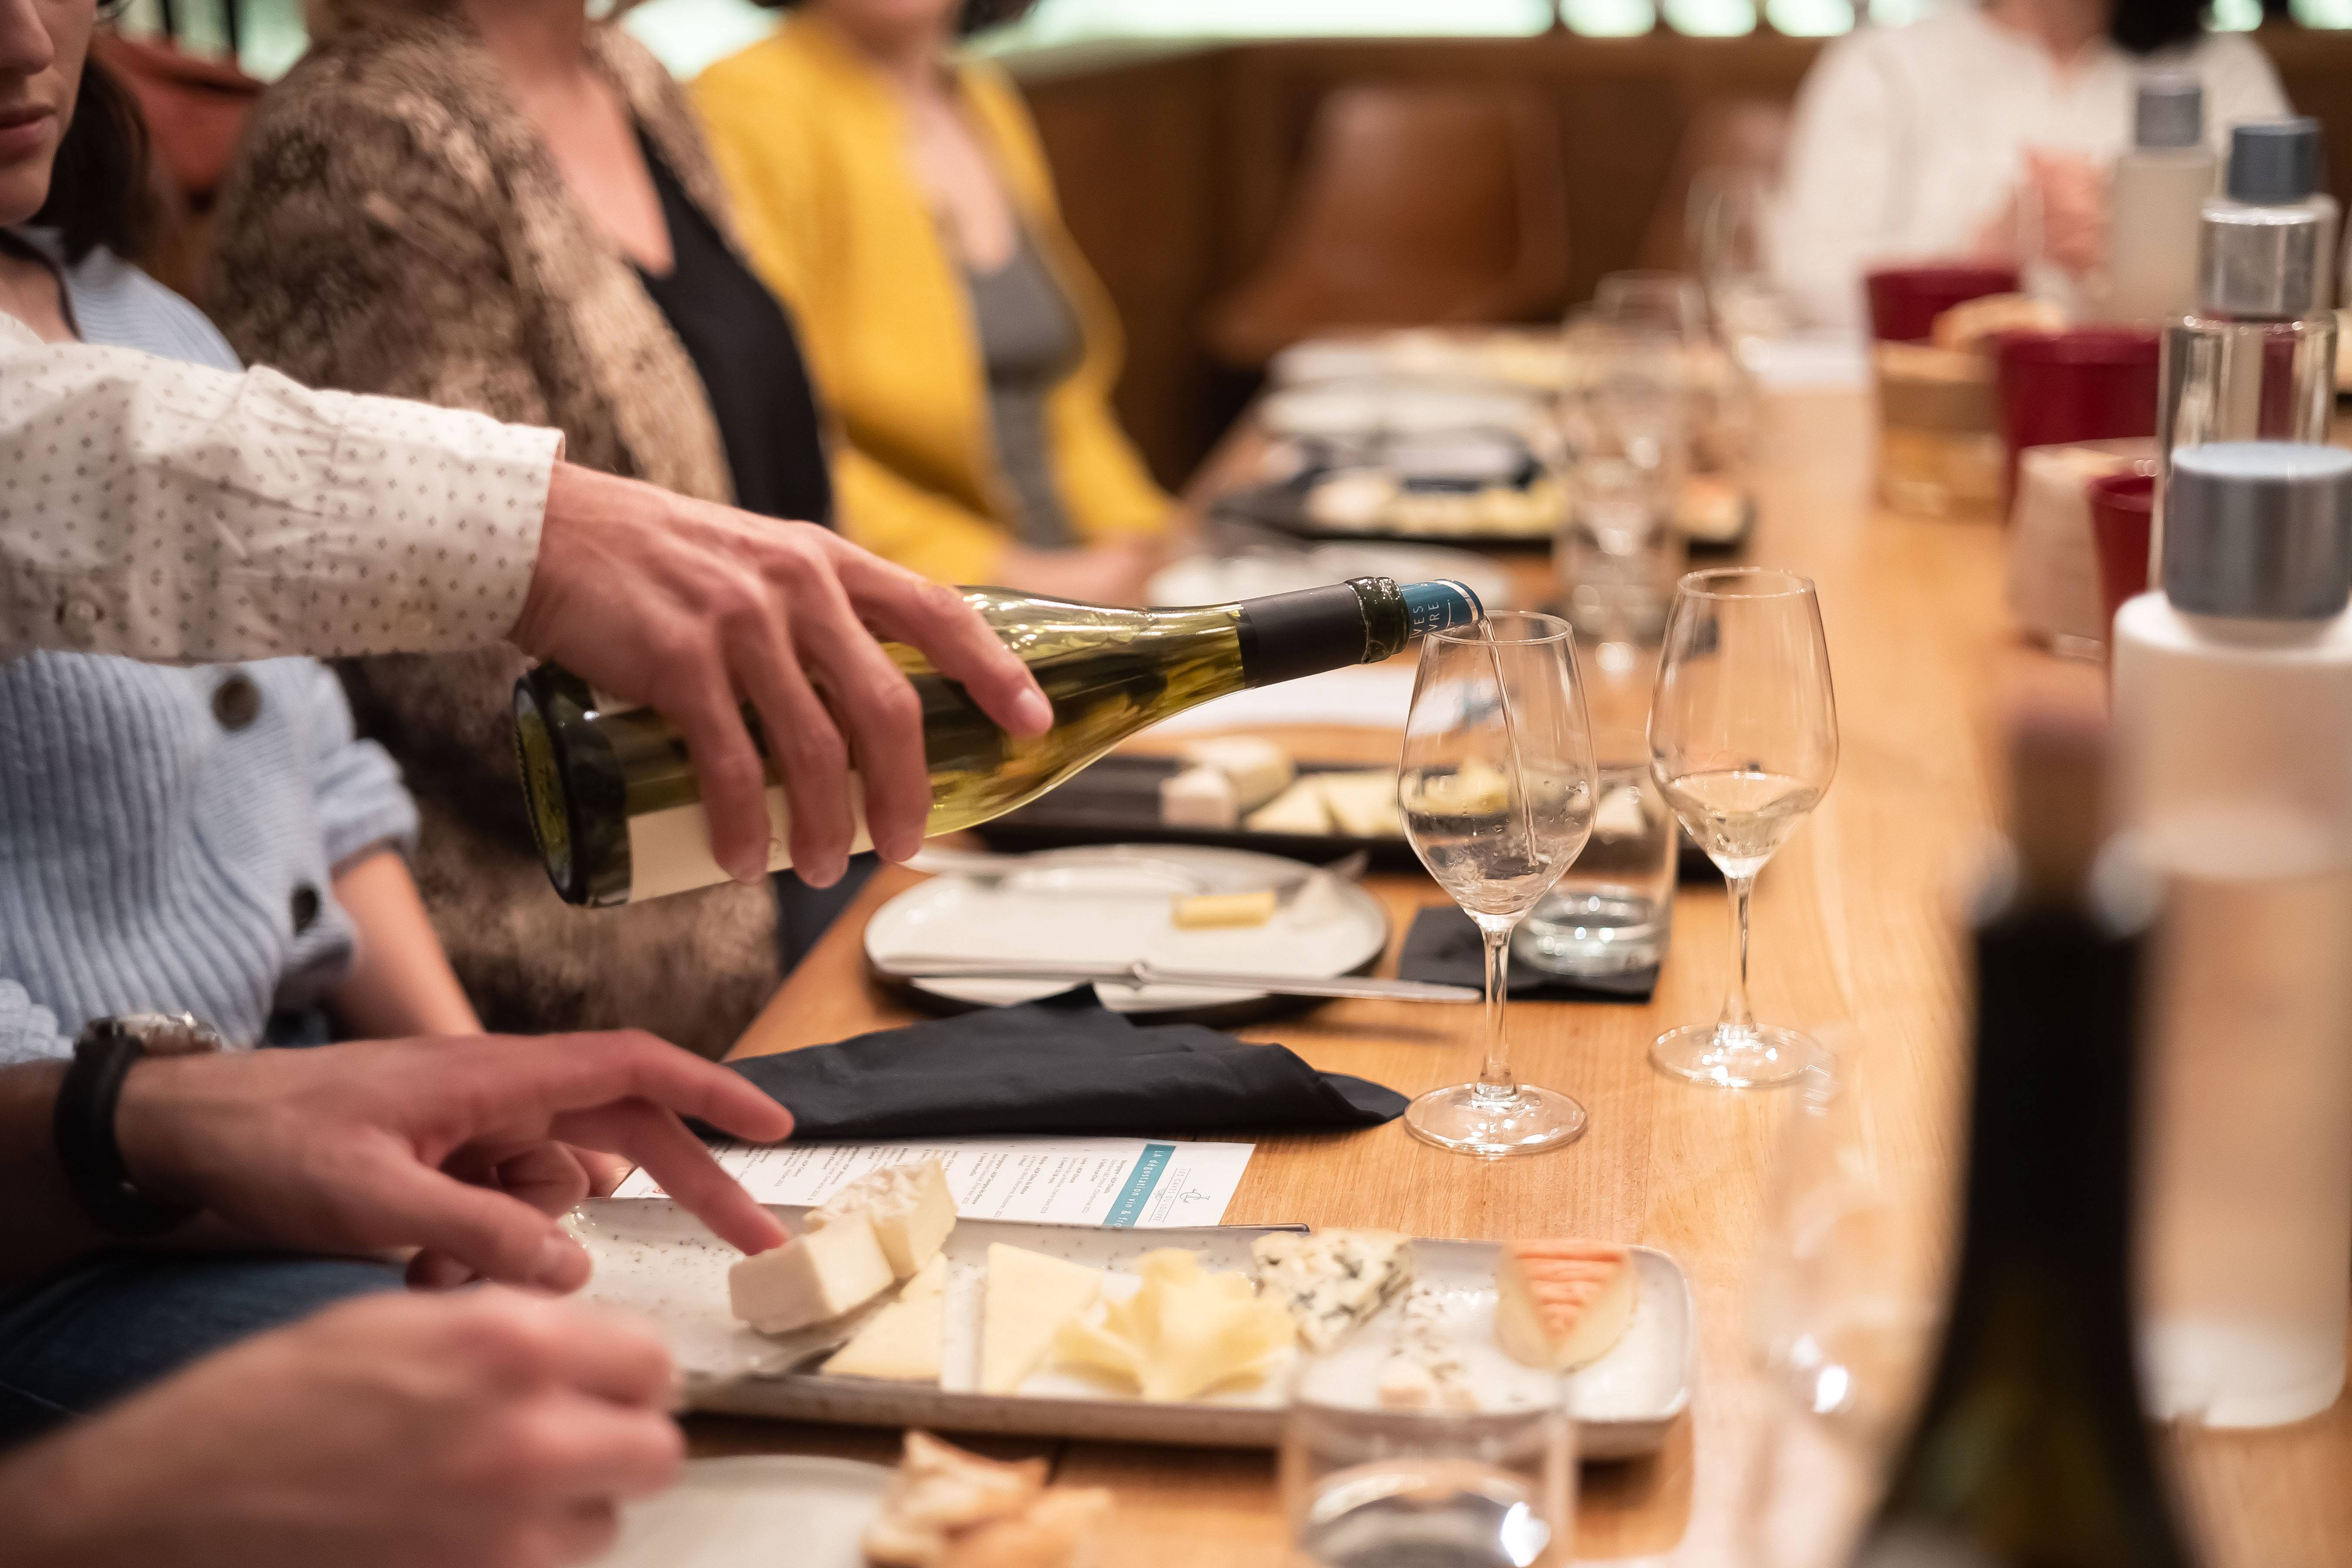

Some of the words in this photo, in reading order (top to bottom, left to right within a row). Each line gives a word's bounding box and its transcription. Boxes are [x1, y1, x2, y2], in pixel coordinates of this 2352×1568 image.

[1114, 1160, 1127, 1174] Bourgogne
[1132, 1160, 1158, 1195] dégustation
[1104, 1184, 1114, 1194] Chablis
[1168, 1179, 1181, 1193] CAVES
[1125, 1198, 1136, 1207] vin
[1153, 1204, 1168, 1221] LOUVRE
